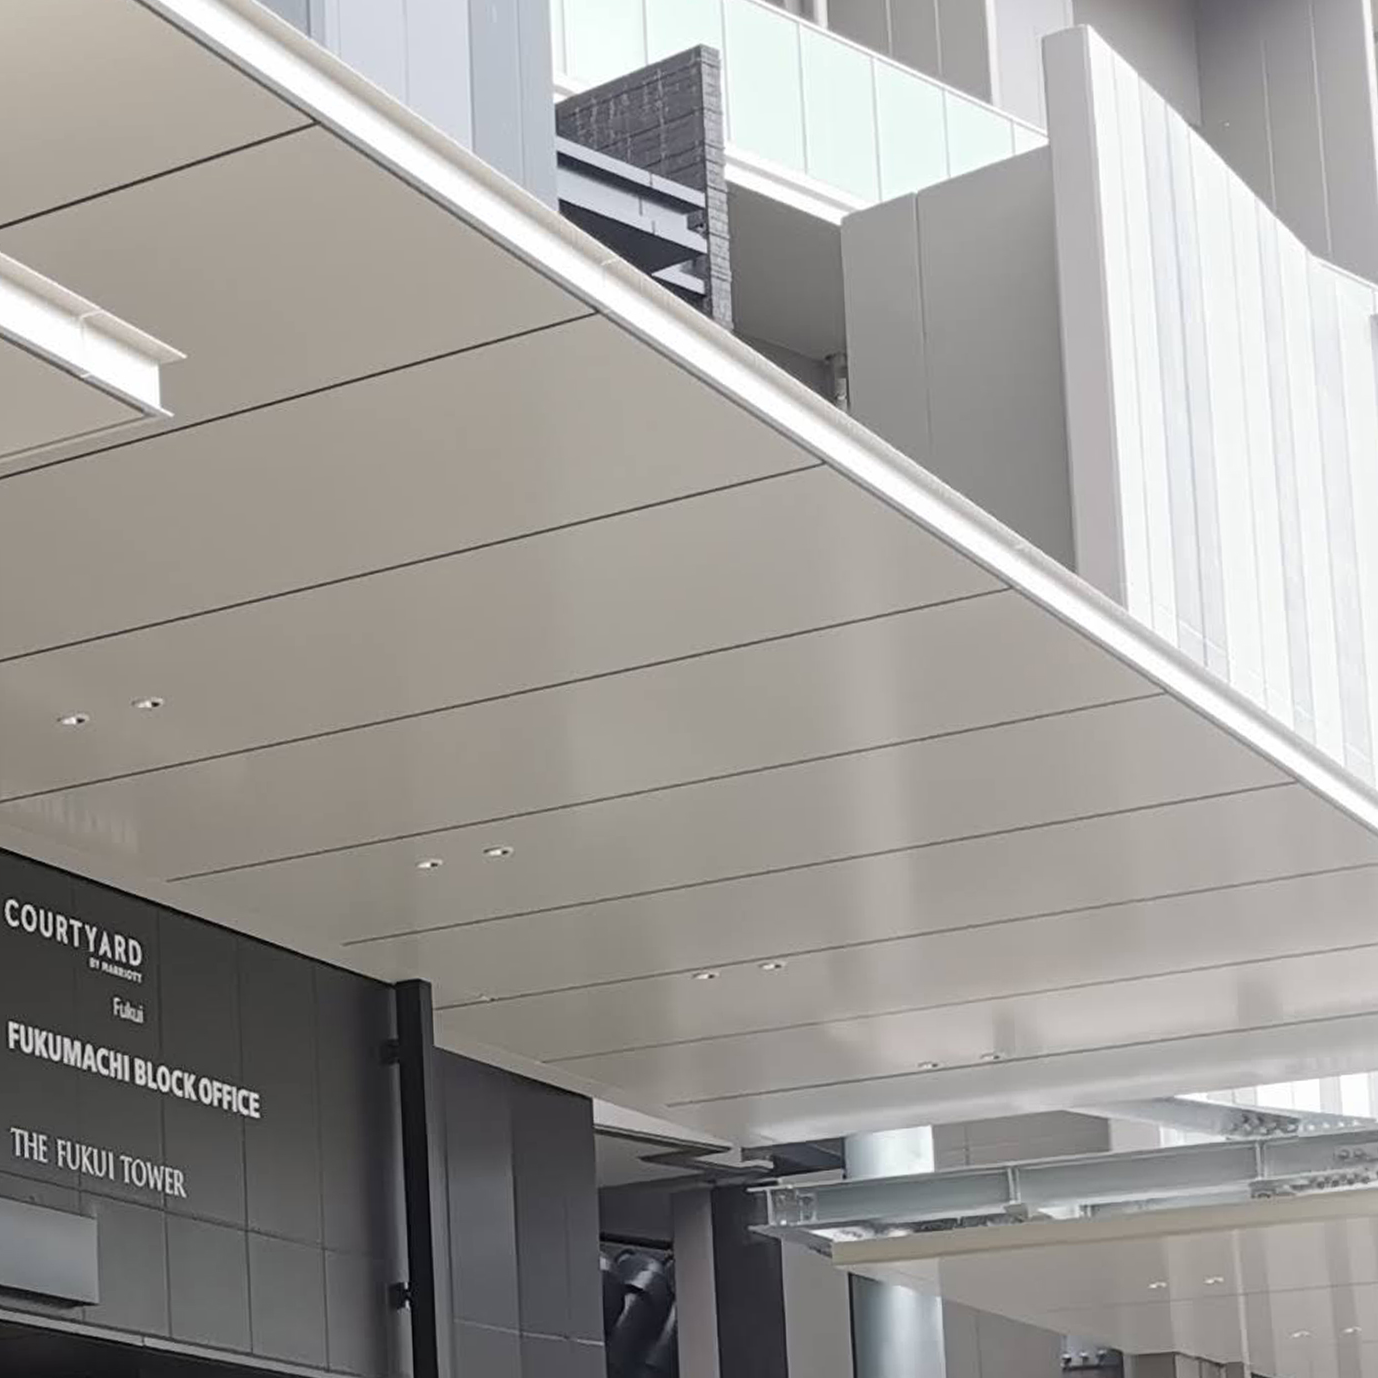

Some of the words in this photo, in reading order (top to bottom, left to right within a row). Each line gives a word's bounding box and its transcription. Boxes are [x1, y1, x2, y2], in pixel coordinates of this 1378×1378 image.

[4, 899, 142, 966] COURTYARD
[102, 961, 142, 983] MARRIOTT
[113, 997, 144, 1024] Fukui
[8, 1021, 129, 1082] FUKUMACHI
[134, 1057, 197, 1101] BLOCK
[199, 1077, 261, 1118] OFFICE
[10, 1127, 48, 1163] THE
[56, 1138, 115, 1180] FUKUI
[120, 1155, 187, 1198] TOWER
